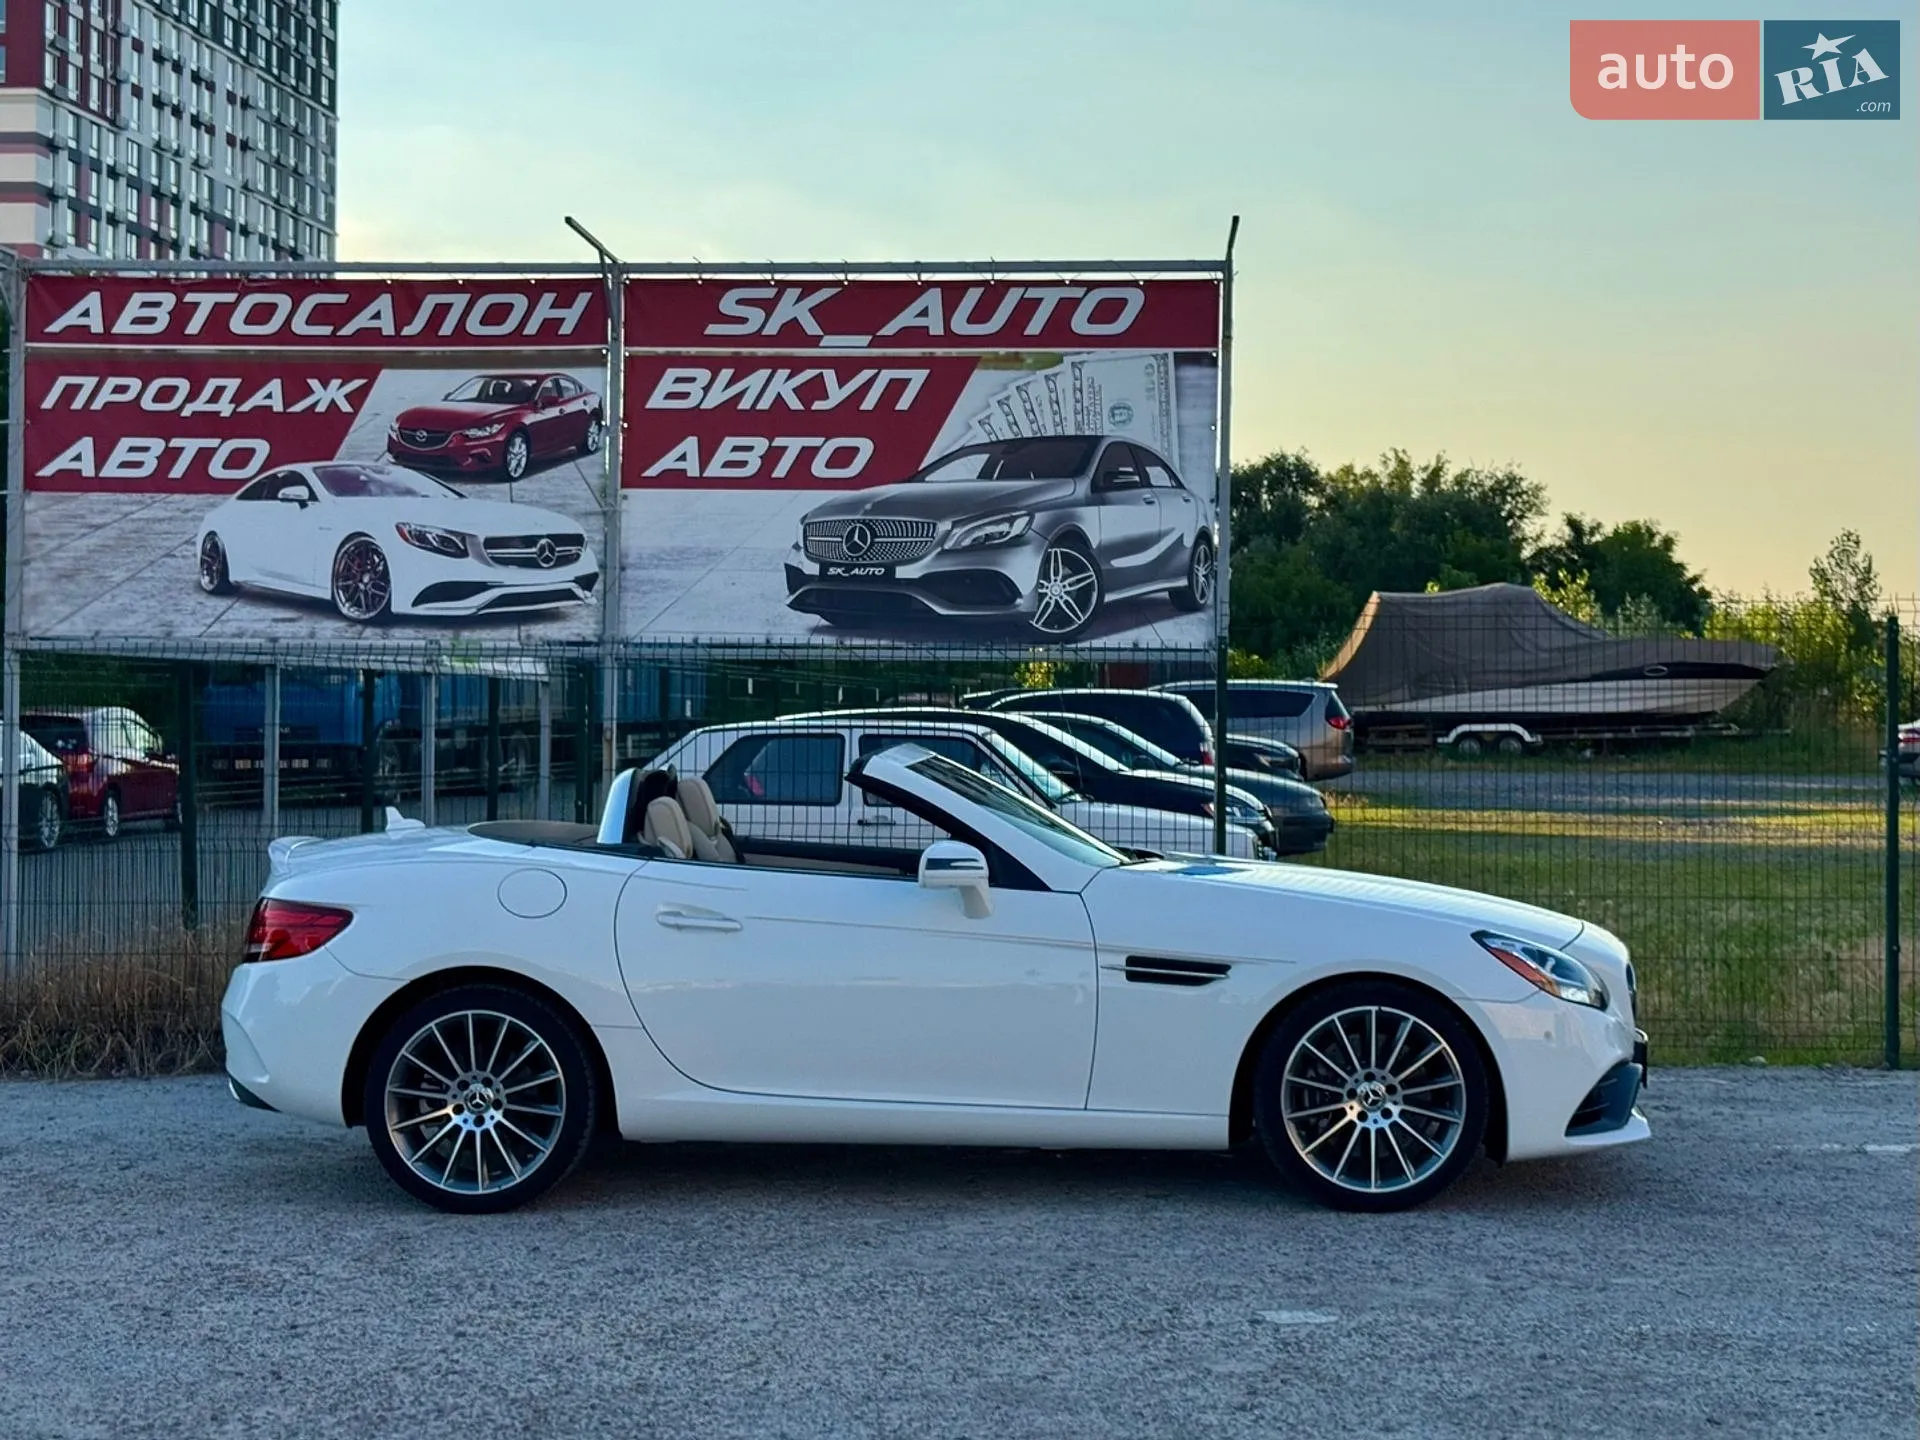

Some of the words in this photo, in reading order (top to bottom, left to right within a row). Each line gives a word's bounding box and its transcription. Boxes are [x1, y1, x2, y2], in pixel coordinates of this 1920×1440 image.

[44, 291, 593, 336] АВТОСАЛОН
[704, 287, 1145, 347] SK_AUTO
[40, 376, 369, 418] ПРОДАЖ
[645, 368, 931, 411] ВИКУП
[35, 437, 271, 480] АВТО
[641, 436, 875, 479] АВТО
[827, 567, 886, 577] SK_AUTO
